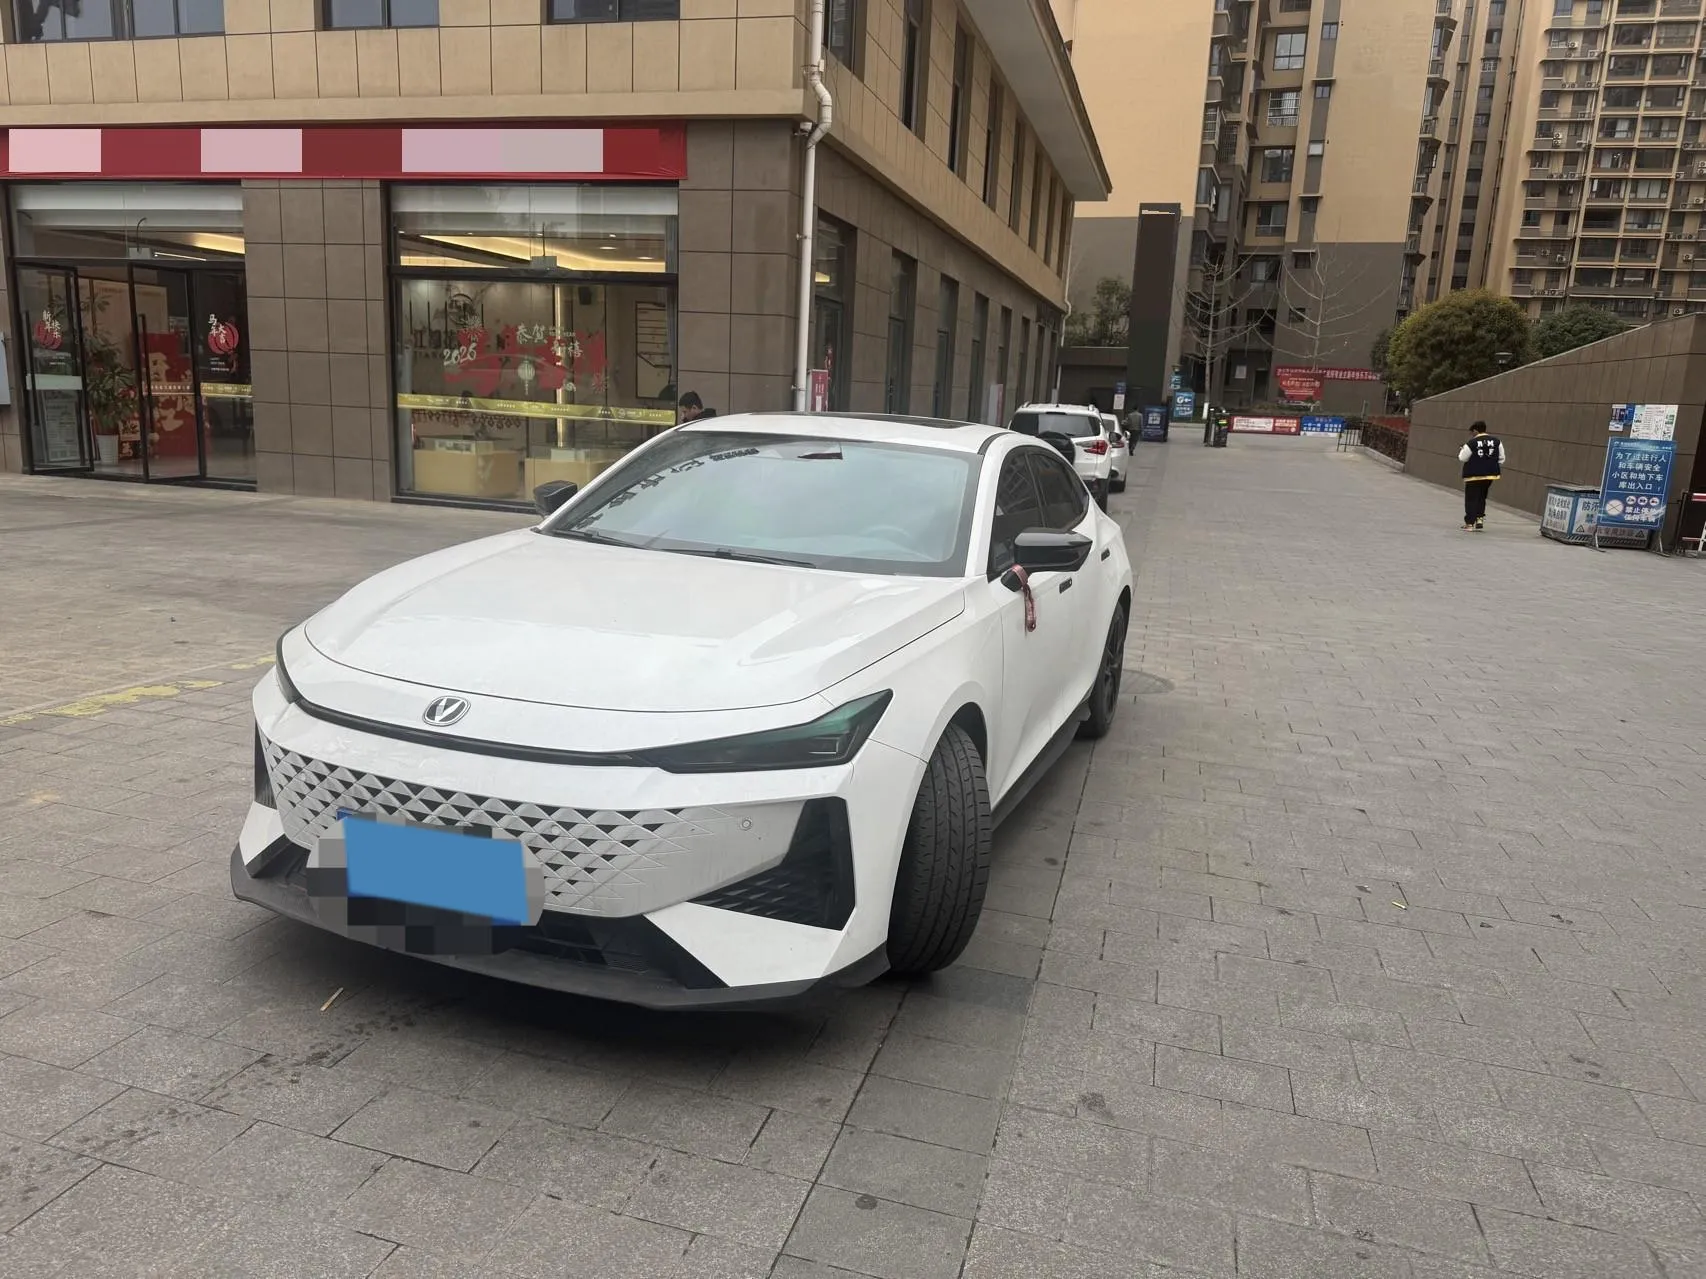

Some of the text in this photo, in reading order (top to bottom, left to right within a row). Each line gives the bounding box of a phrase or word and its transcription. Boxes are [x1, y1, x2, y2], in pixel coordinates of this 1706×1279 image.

[443, 342, 478, 366] 2026
[1615, 451, 1667, 463] 为了过往行人
[1618, 462, 1661, 472] 和车辆安全
[1611, 471, 1664, 481] 小区和地下车
